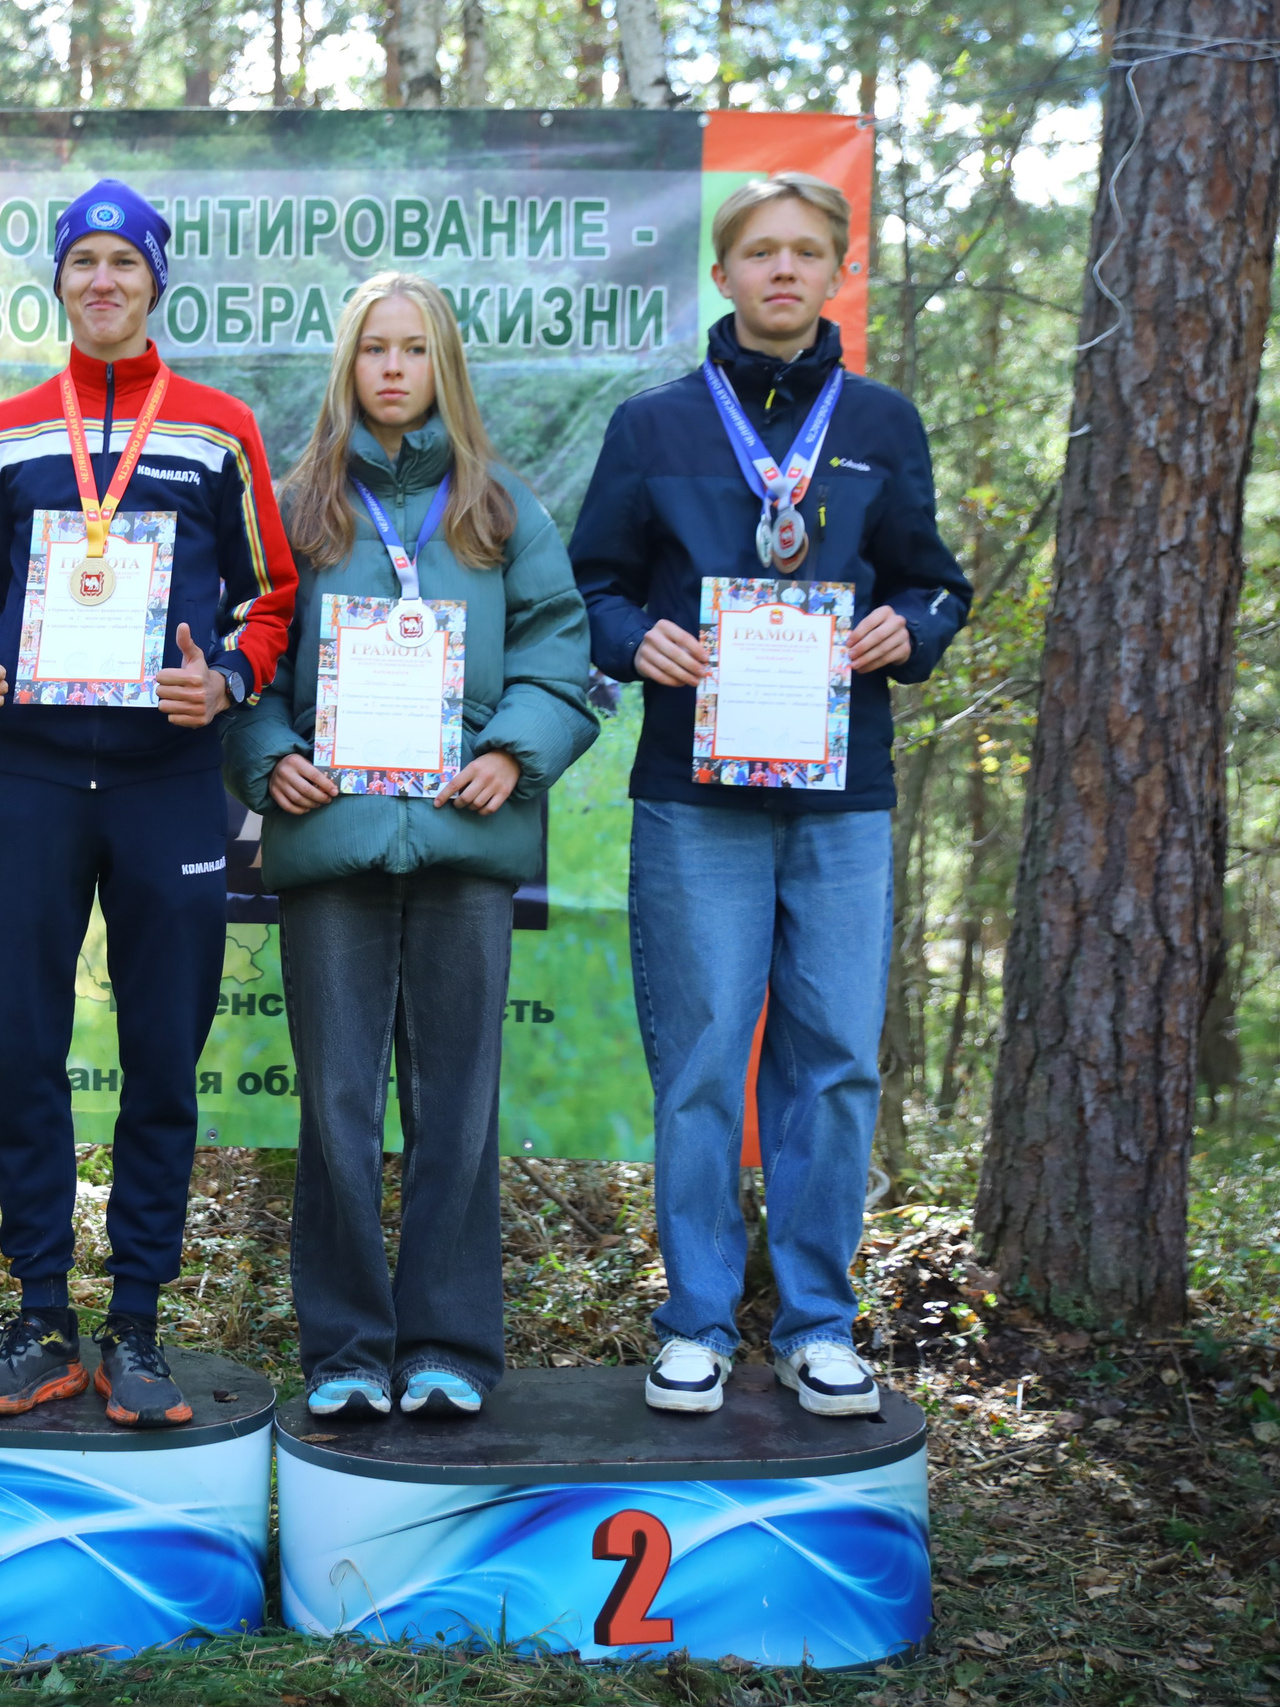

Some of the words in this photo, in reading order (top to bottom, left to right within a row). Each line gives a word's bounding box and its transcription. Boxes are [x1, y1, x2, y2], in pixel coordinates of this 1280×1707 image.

[165, 284, 354, 347] ОБРА
[444, 284, 668, 350] ЖИЗНИ
[63, 379, 78, 417] ОБЛАСТЬ
[69, 417, 90, 483] ЧЕЛЯБИНСКАЯ
[117, 440, 141, 481] ОБЛАСТЬ
[136, 464, 201, 486] КОМАНДА74
[60, 557, 140, 569] ГРОТА
[733, 627, 818, 642] ГРАМОТА
[352, 643, 432, 657] ГРАМОТА
[181, 855, 226, 876] КОМАНДА
[591, 1508, 675, 1647] 2
